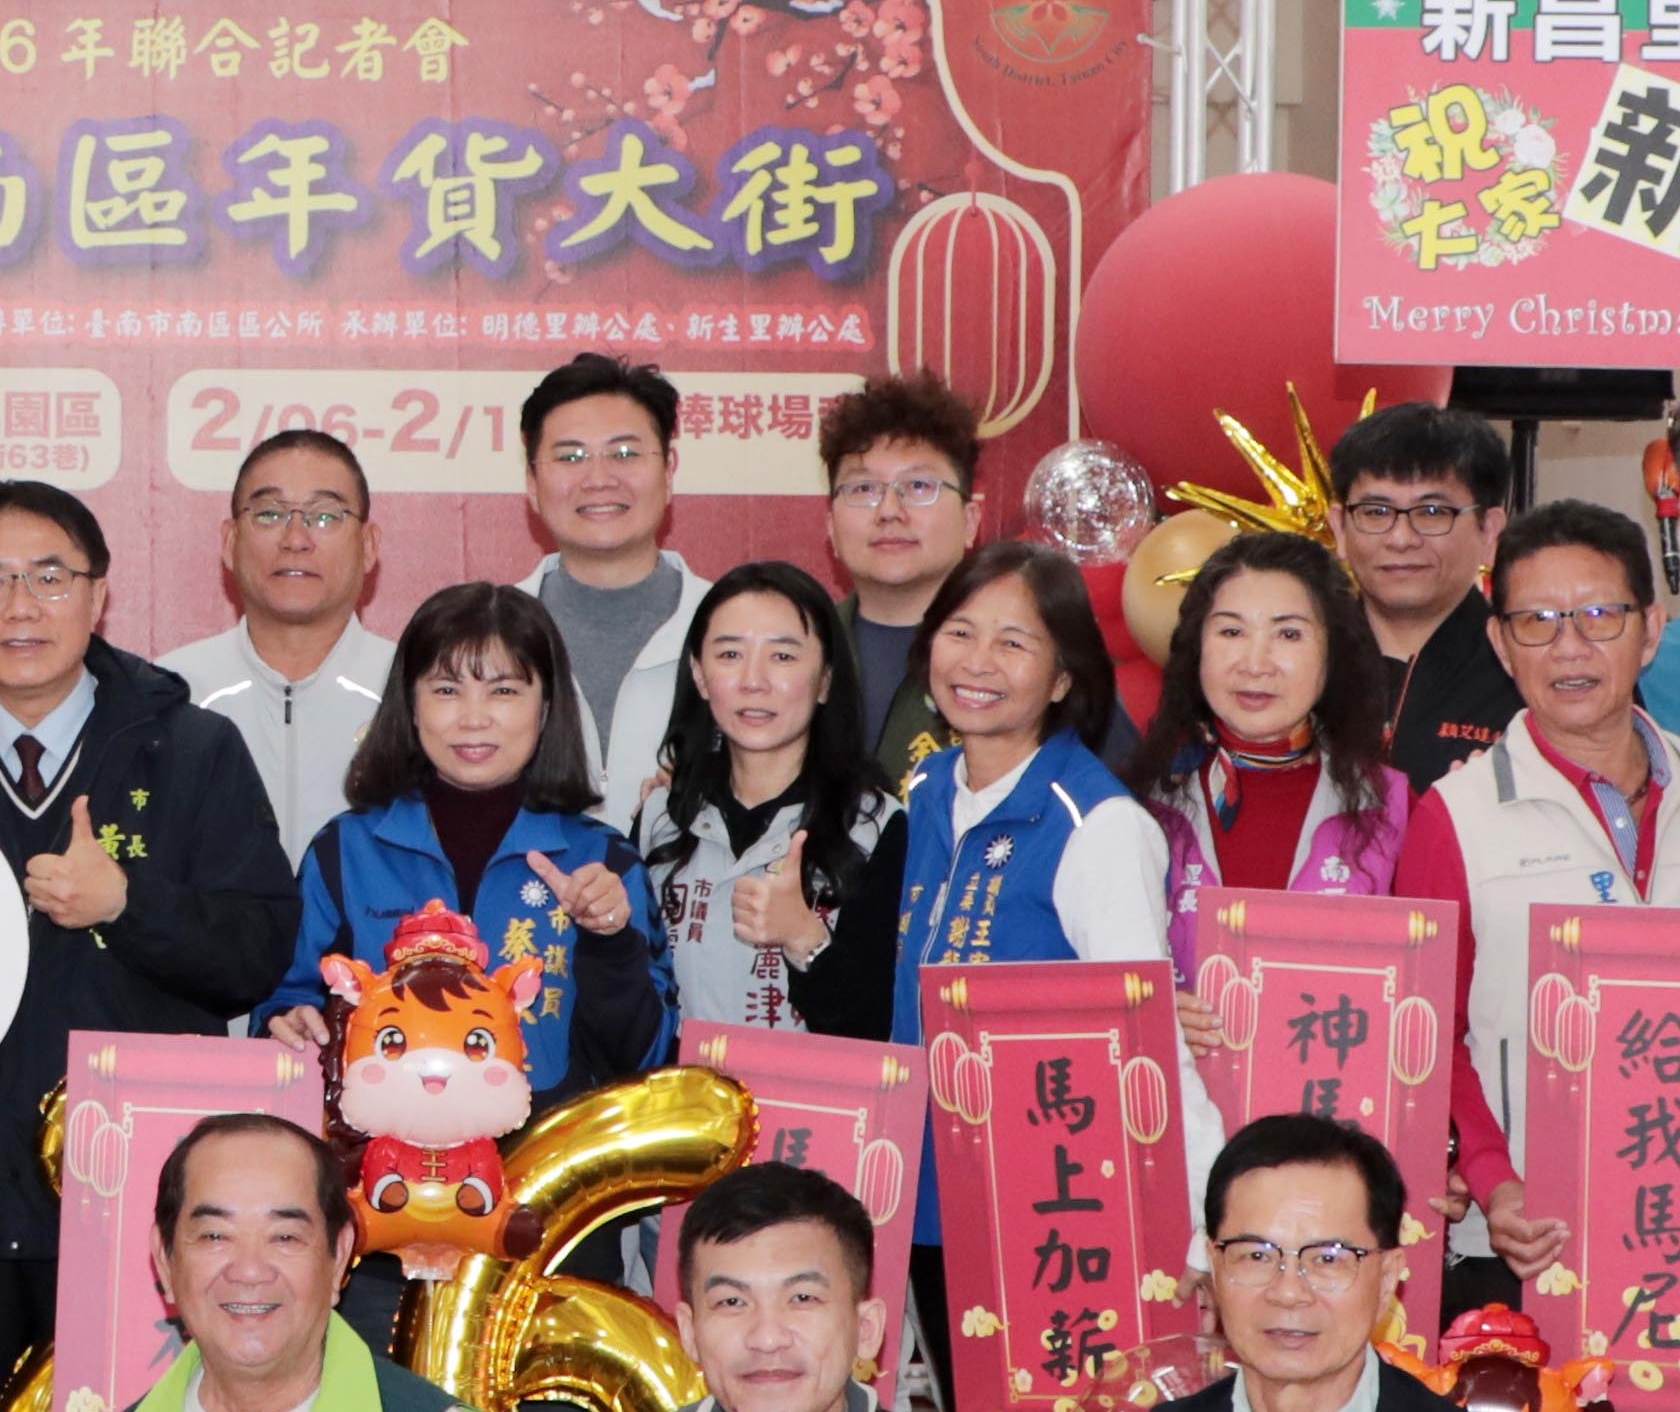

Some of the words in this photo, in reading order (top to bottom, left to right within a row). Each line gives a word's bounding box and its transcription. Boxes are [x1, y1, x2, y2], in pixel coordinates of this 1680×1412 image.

[84, 306, 325, 341] 臺南市南區區公所
[481, 309, 868, 345] 明德里辦公處、新生里辦公處
[1362, 294, 1496, 341] Merry
[673, 394, 845, 442] 棒球場
[126, 788, 151, 859] 市長
[686, 878, 714, 944] 市議員
[539, 905, 572, 1020] 市議員
[1026, 1056, 1119, 1384] 馬上加薪
